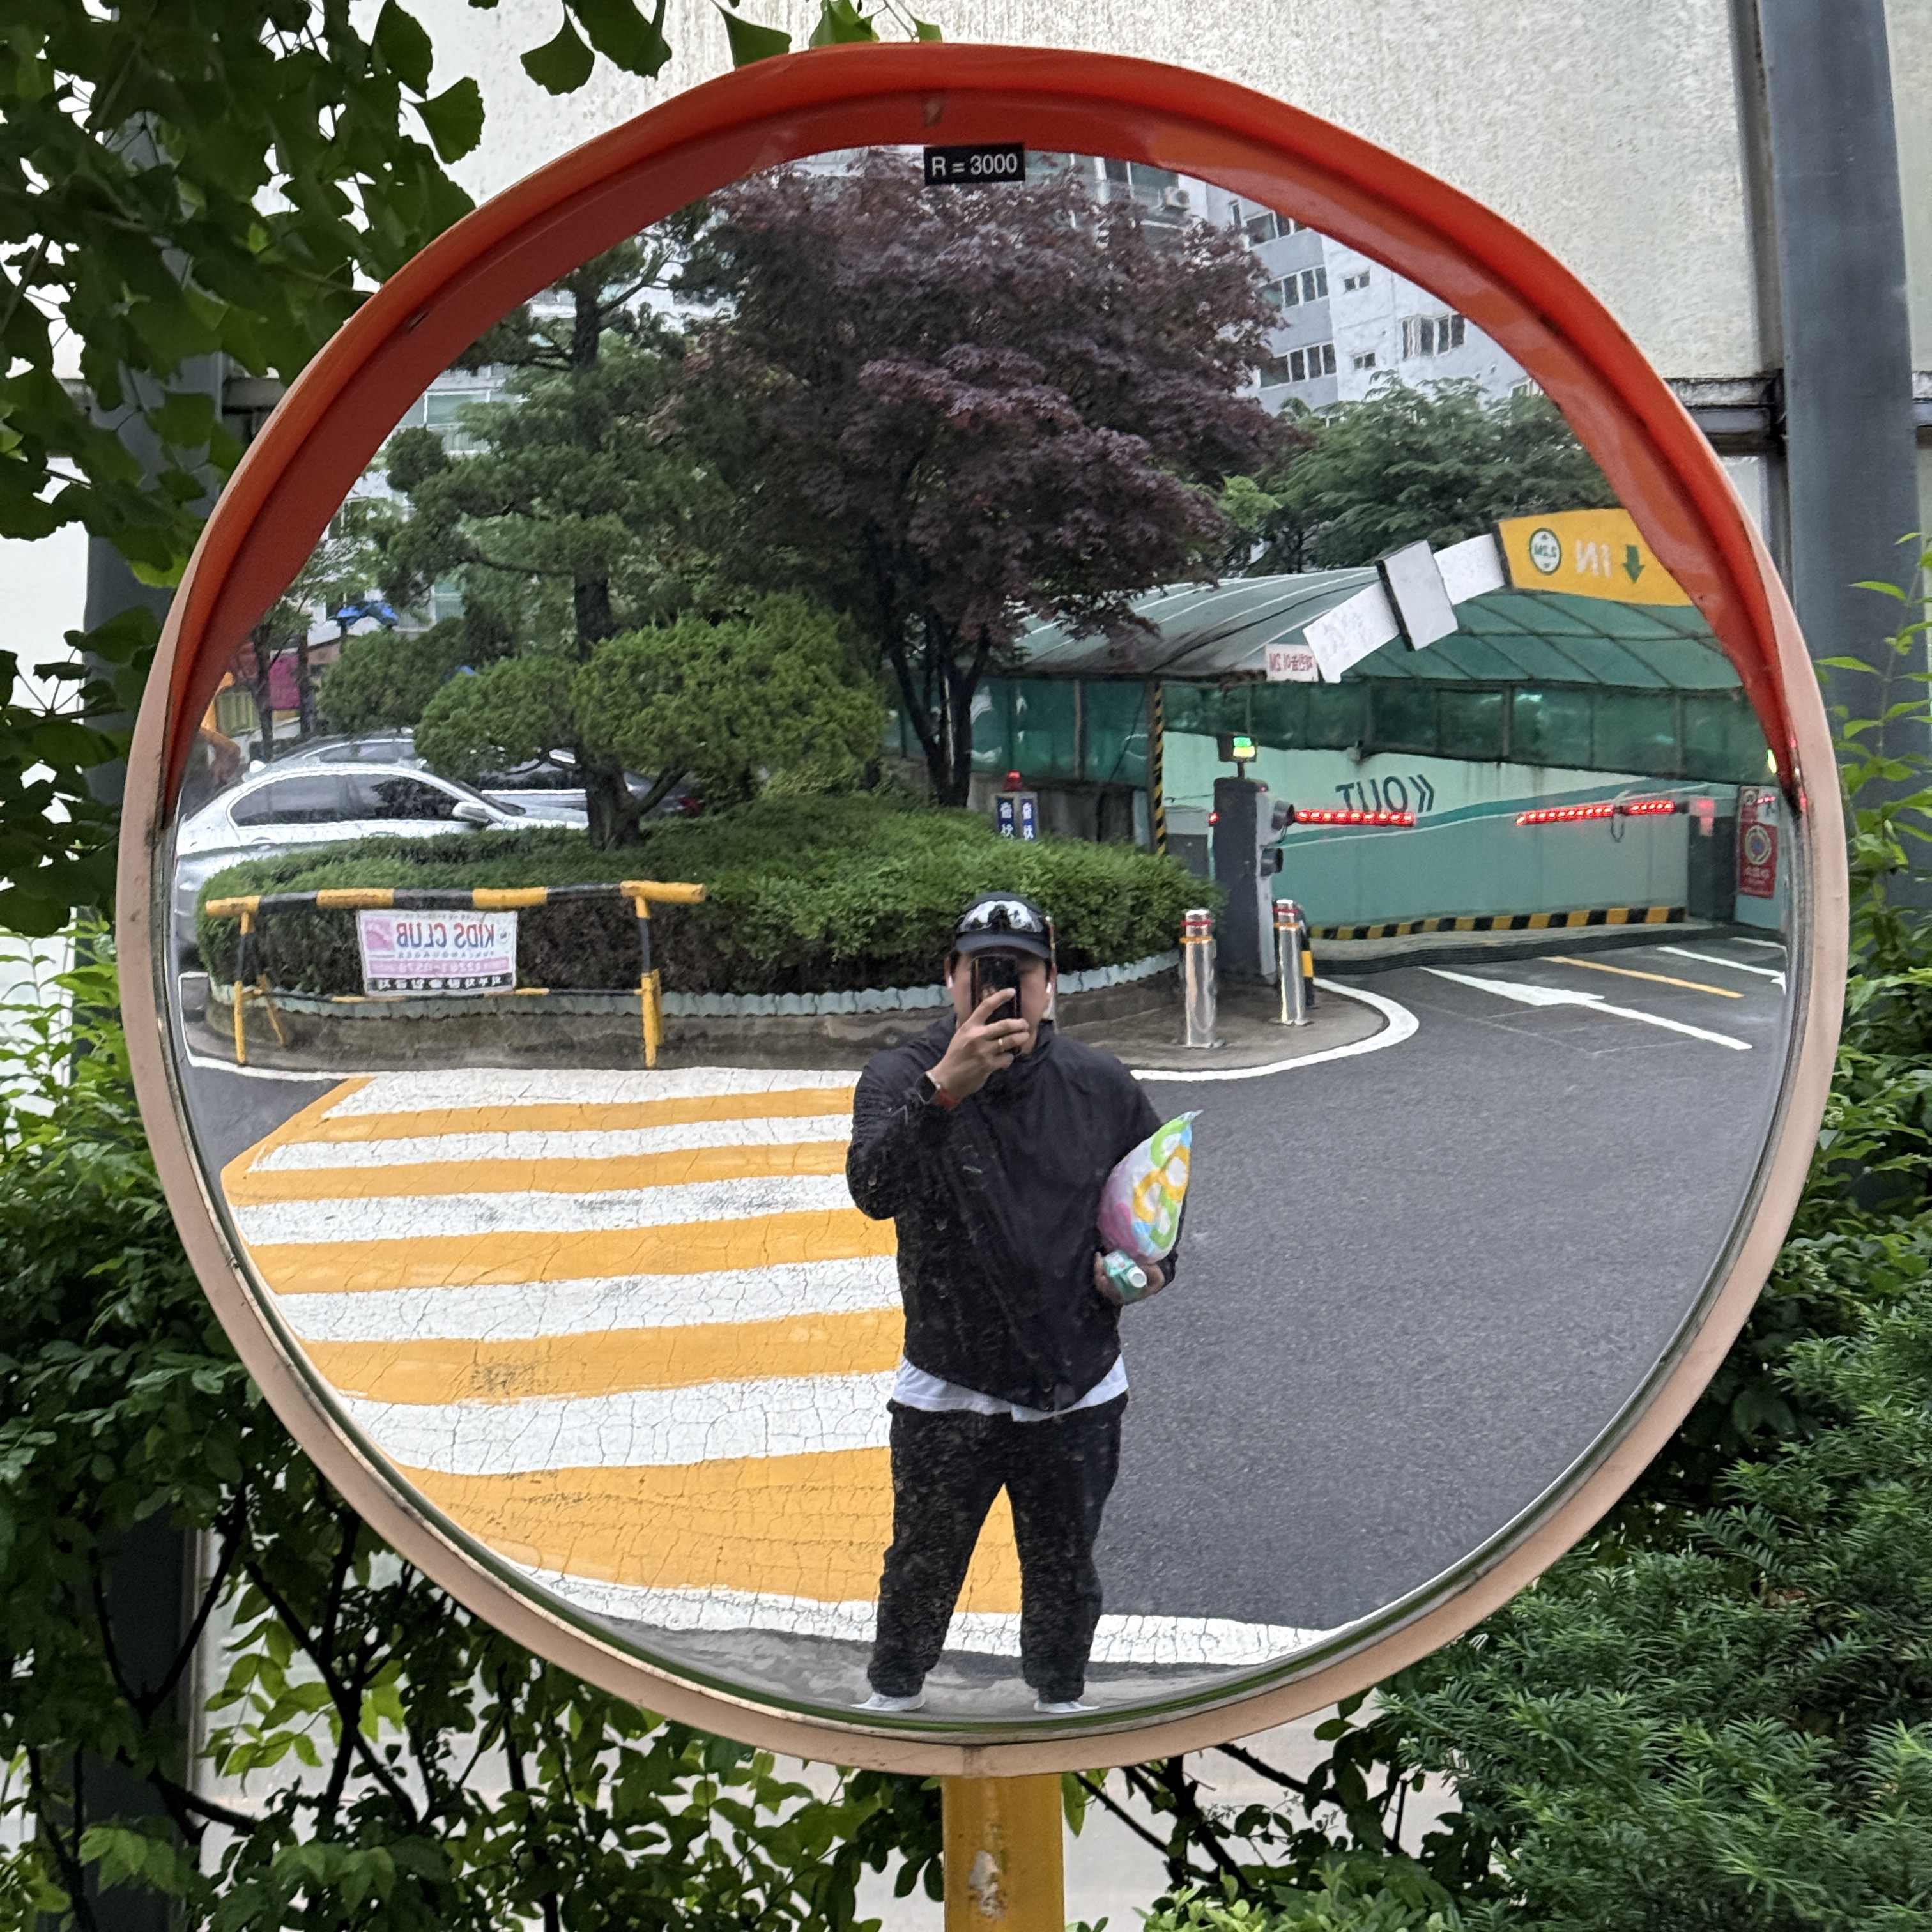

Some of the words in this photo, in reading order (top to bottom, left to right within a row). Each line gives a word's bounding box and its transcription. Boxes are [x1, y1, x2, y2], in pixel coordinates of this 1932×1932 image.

[931, 156, 946, 176] R
[952, 162, 965, 173] =
[970, 153, 1017, 175] 3000
